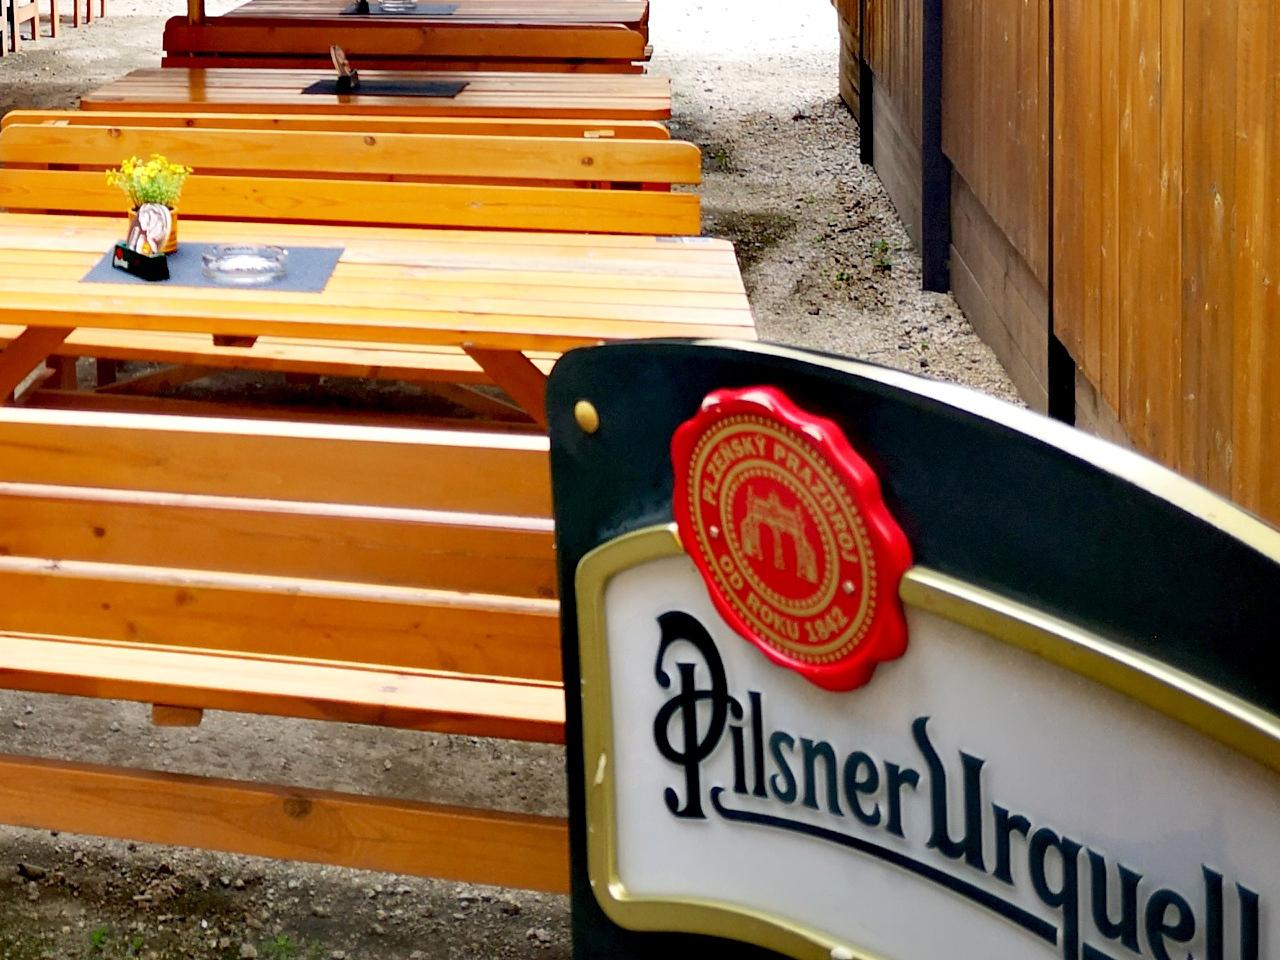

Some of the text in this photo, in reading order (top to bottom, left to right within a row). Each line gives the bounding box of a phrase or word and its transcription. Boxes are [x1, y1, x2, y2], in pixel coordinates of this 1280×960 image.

[774, 443, 858, 562] PRAZDROJ
[720, 555, 849, 642] OD ROKU 1842
[653, 610, 1259, 960] Pilsner Urquell
